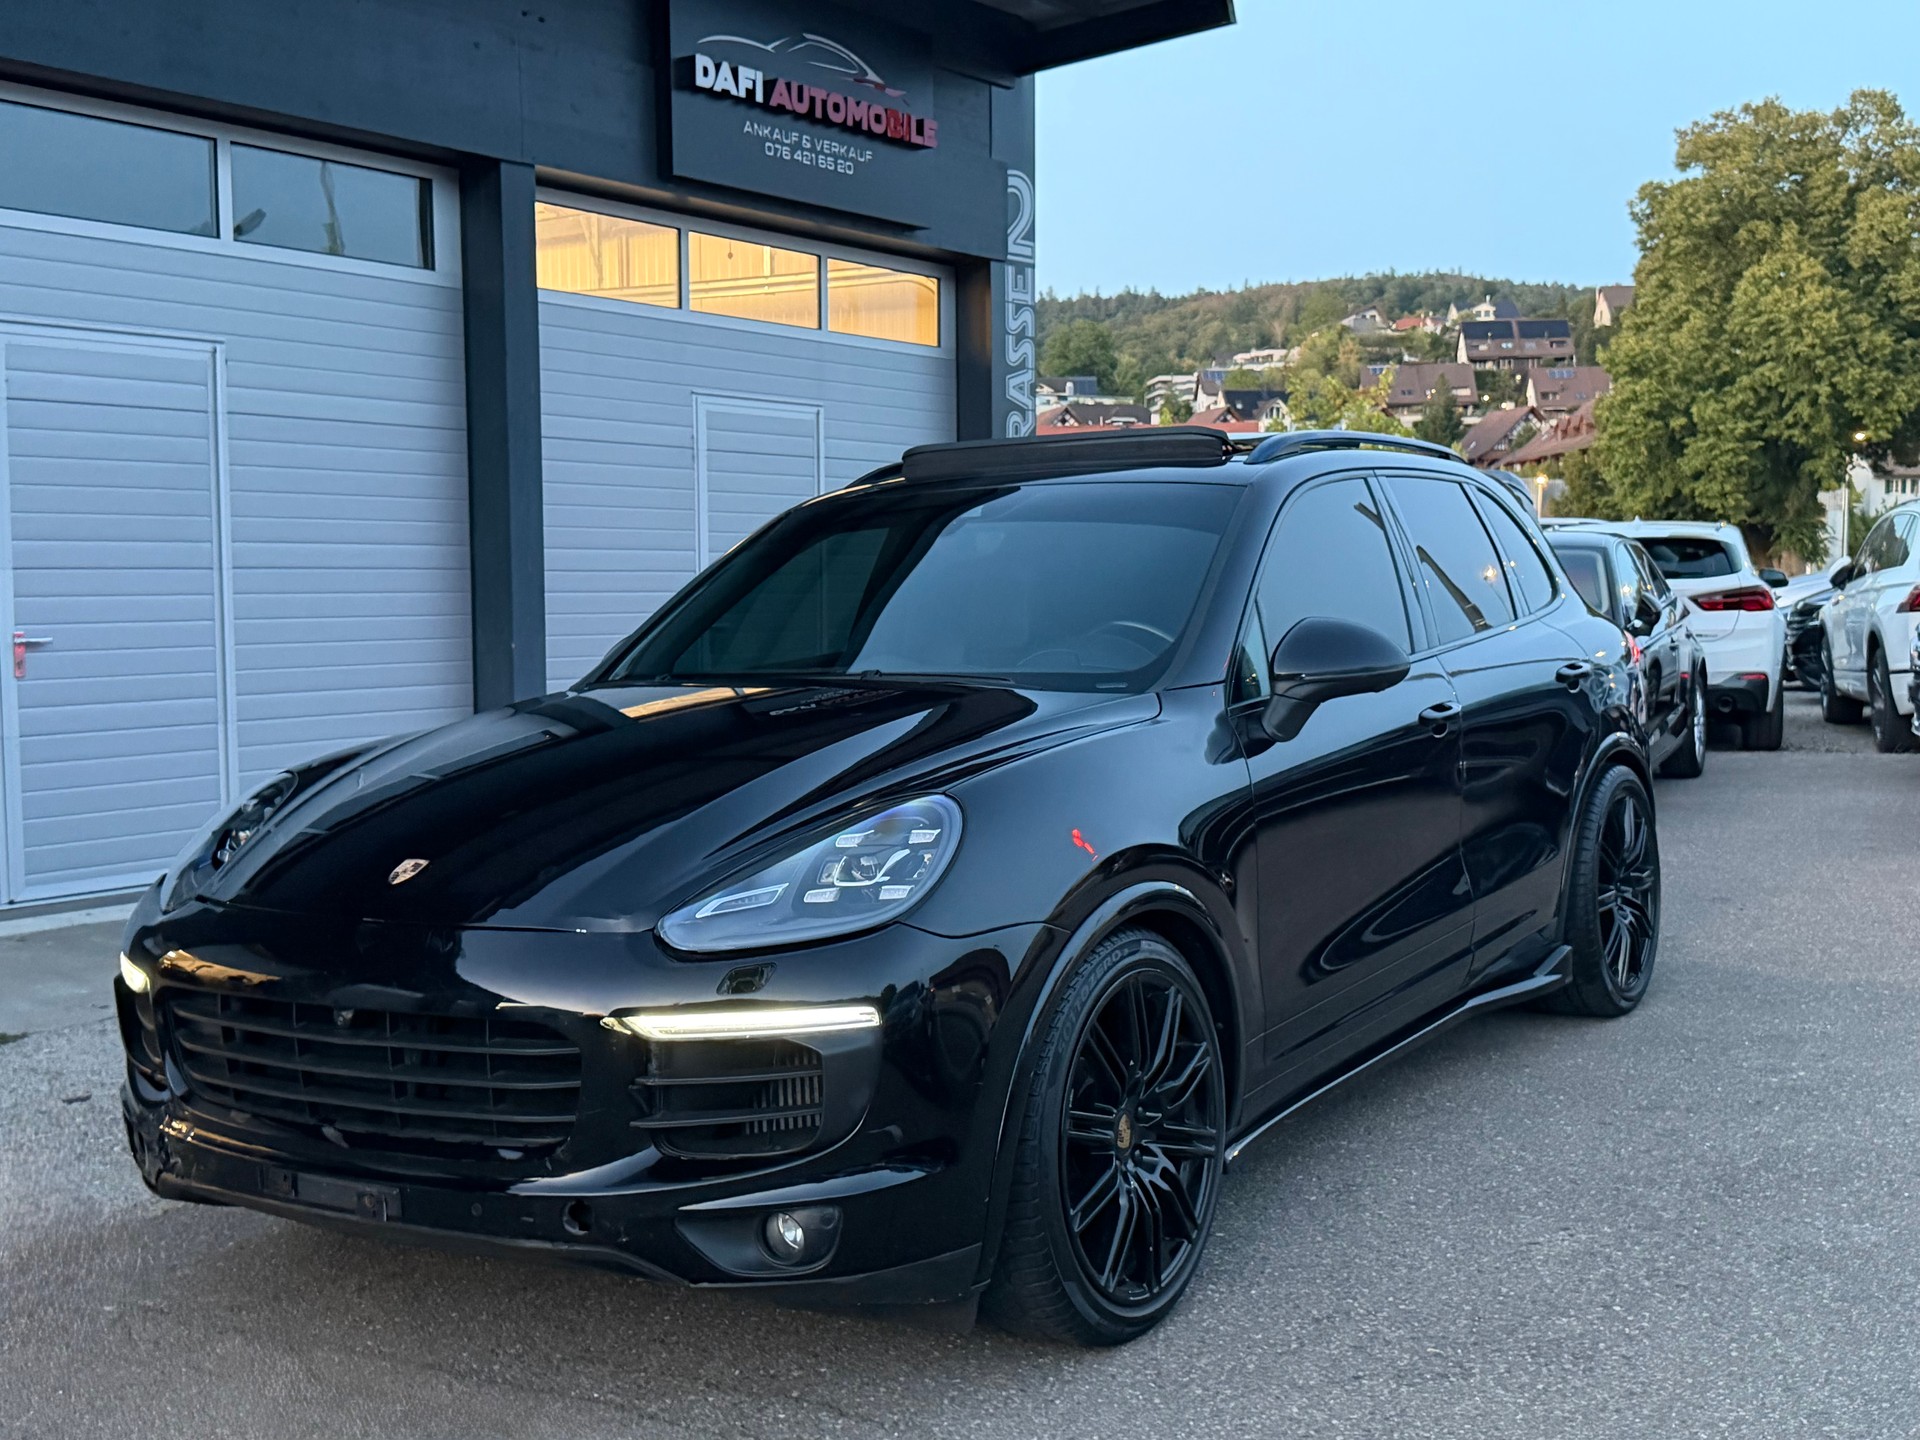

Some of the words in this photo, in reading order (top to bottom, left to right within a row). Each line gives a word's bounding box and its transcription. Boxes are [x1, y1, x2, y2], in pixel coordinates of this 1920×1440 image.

[694, 53, 764, 104] DAFI
[768, 77, 938, 149] AUTOMOBILE
[743, 120, 799, 145] ANKAUF
[801, 134, 812, 149] &
[814, 138, 874, 163] VERKAUF
[764, 141, 791, 161] 076
[793, 150, 816, 166] 421
[818, 155, 835, 171] 65
[836, 159, 855, 175] 20
